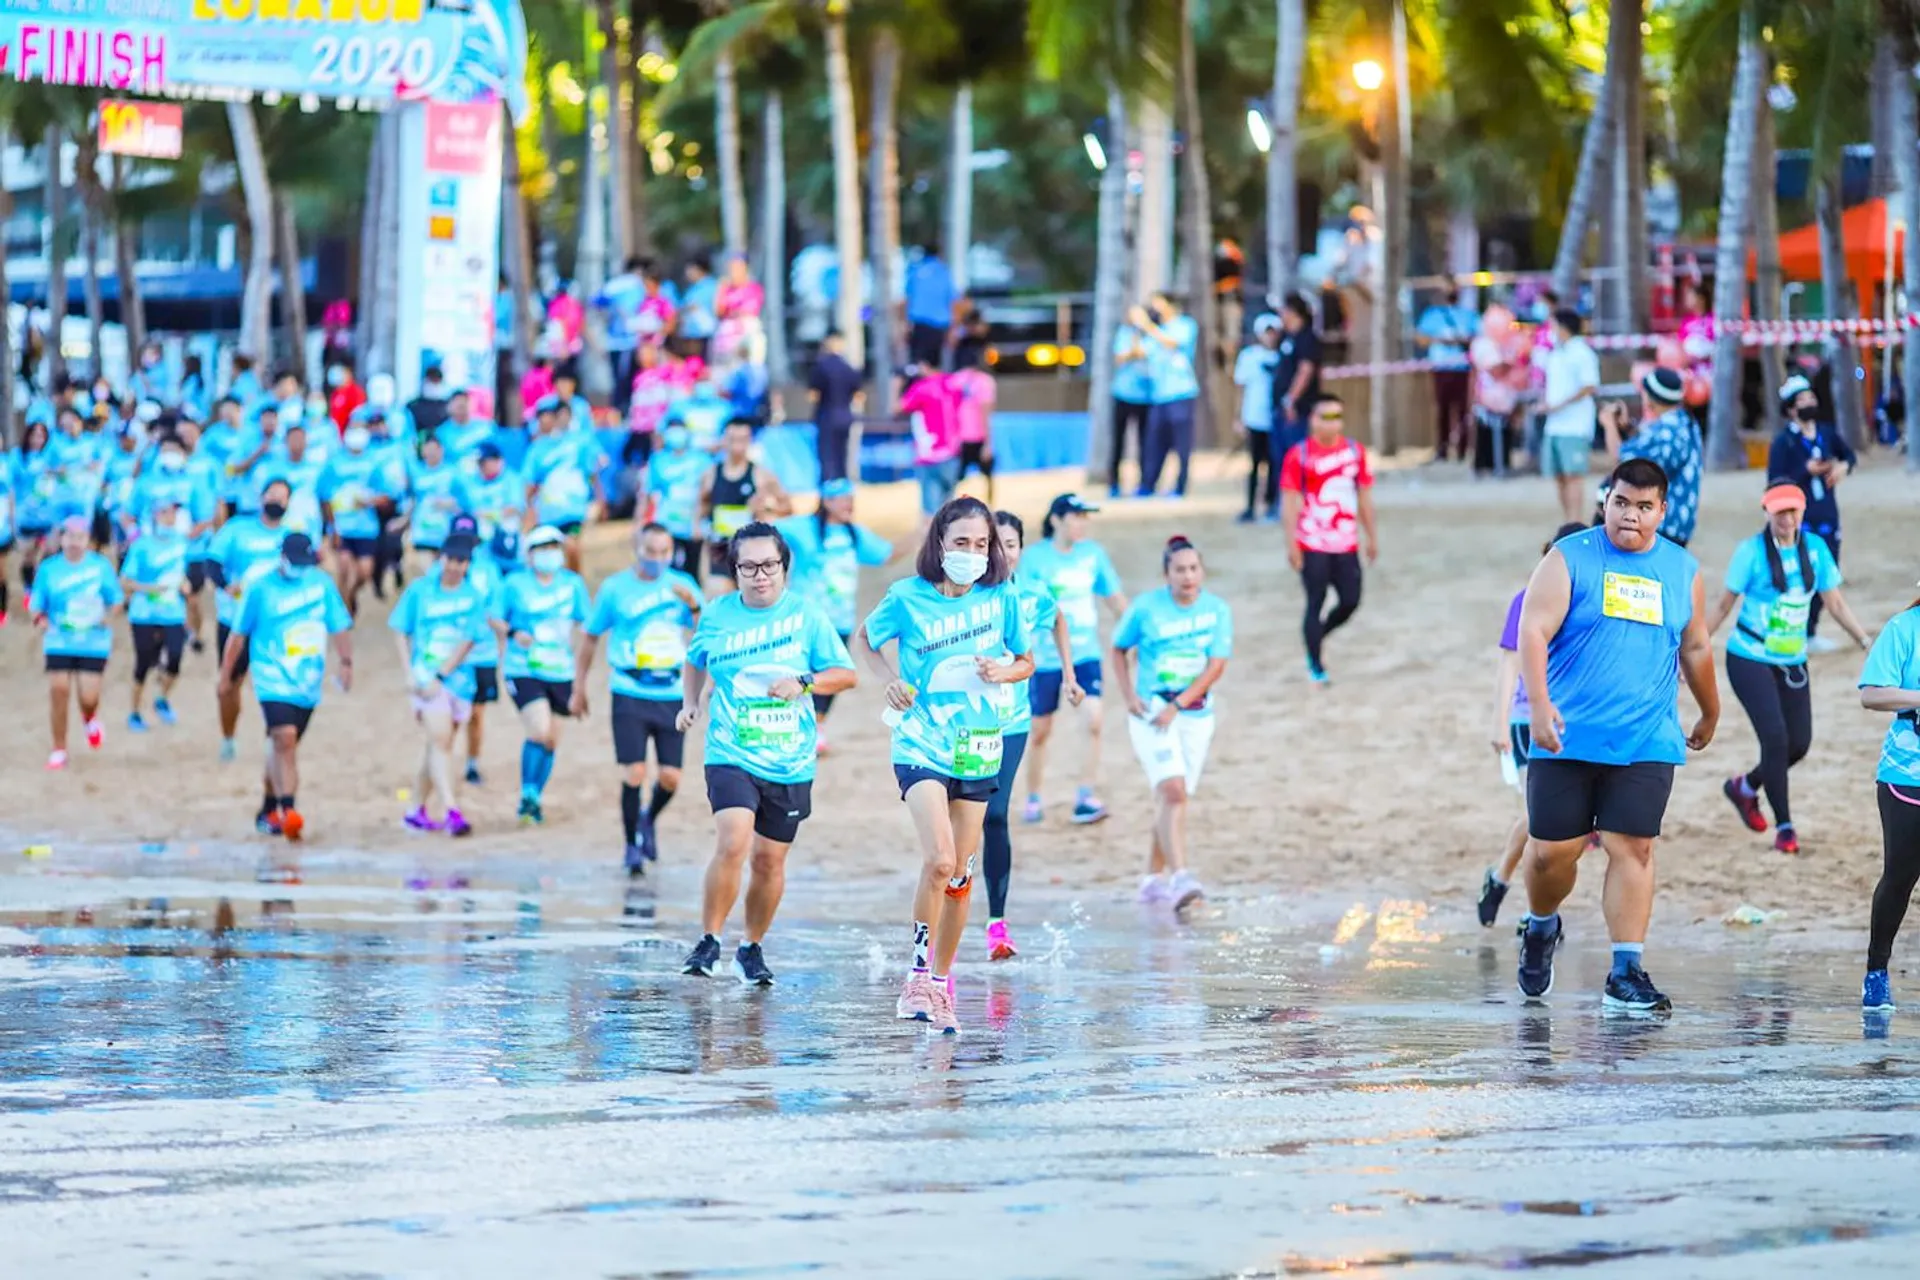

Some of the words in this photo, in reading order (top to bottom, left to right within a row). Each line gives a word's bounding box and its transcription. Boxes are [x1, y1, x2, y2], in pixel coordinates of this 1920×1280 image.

[18, 25, 166, 93] FINISH
[309, 35, 434, 87] 2020
[924, 611, 968, 641] LOMA
[970, 597, 1001, 625] RUN
